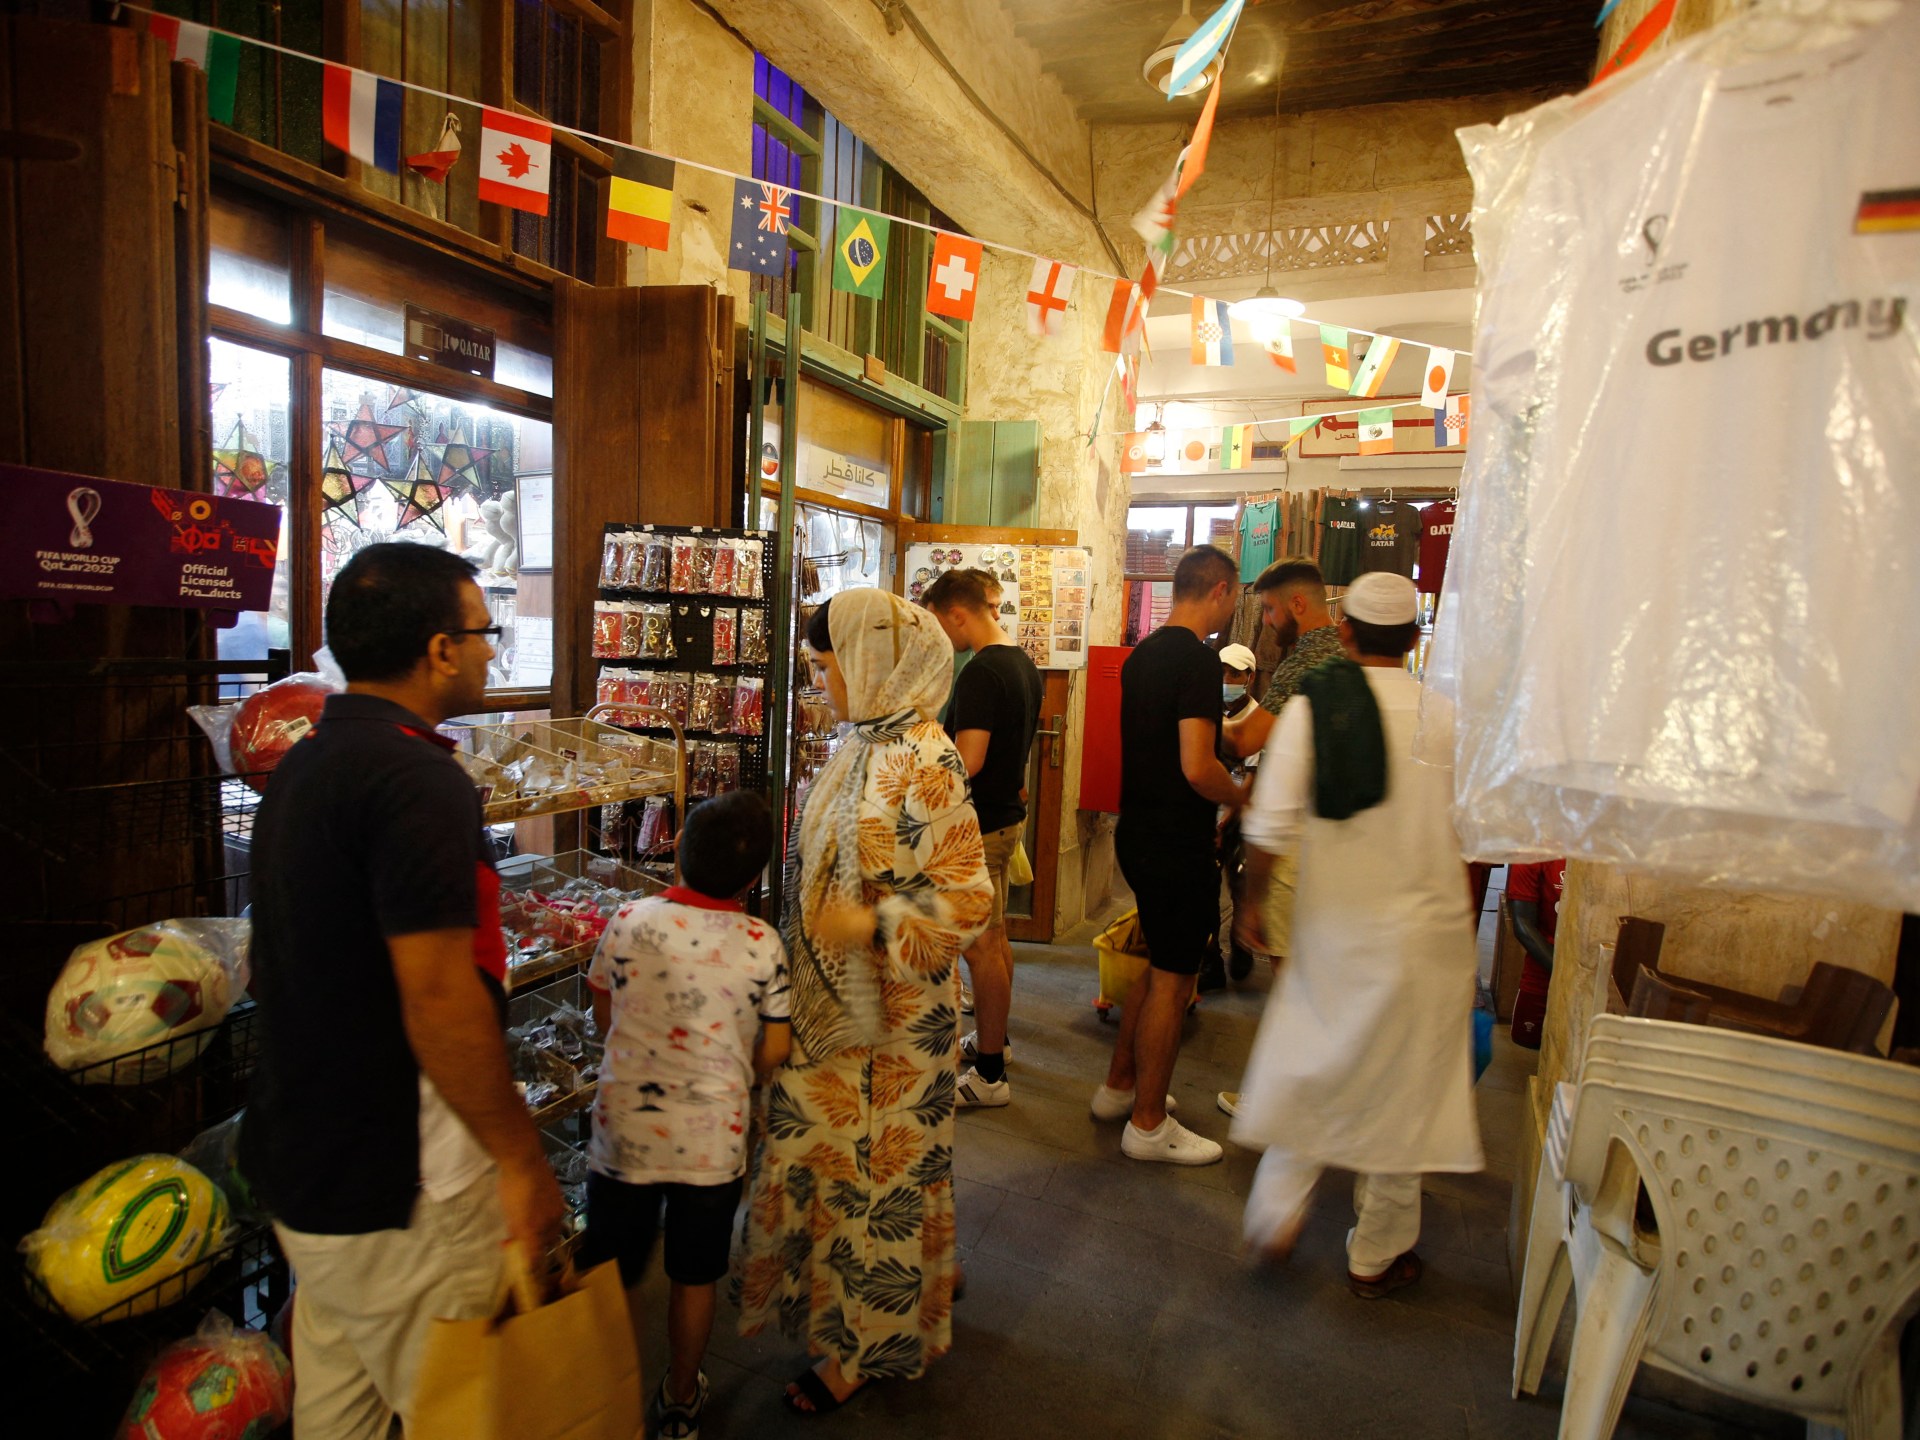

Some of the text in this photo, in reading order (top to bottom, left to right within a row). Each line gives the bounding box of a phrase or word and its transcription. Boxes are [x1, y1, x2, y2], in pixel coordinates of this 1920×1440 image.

[1646, 297, 1907, 367] Germany
[460, 339, 491, 361] QATAR
[823, 458, 854, 481] قطر
[1336, 520, 1356, 530] QATAR
[1430, 524, 1455, 536] QAT
[36, 550, 121, 565] FIFA WORLD CUP
[182, 563, 228, 577] Official
[181, 574, 234, 588] Licensed
[180, 586, 242, 599] Products
